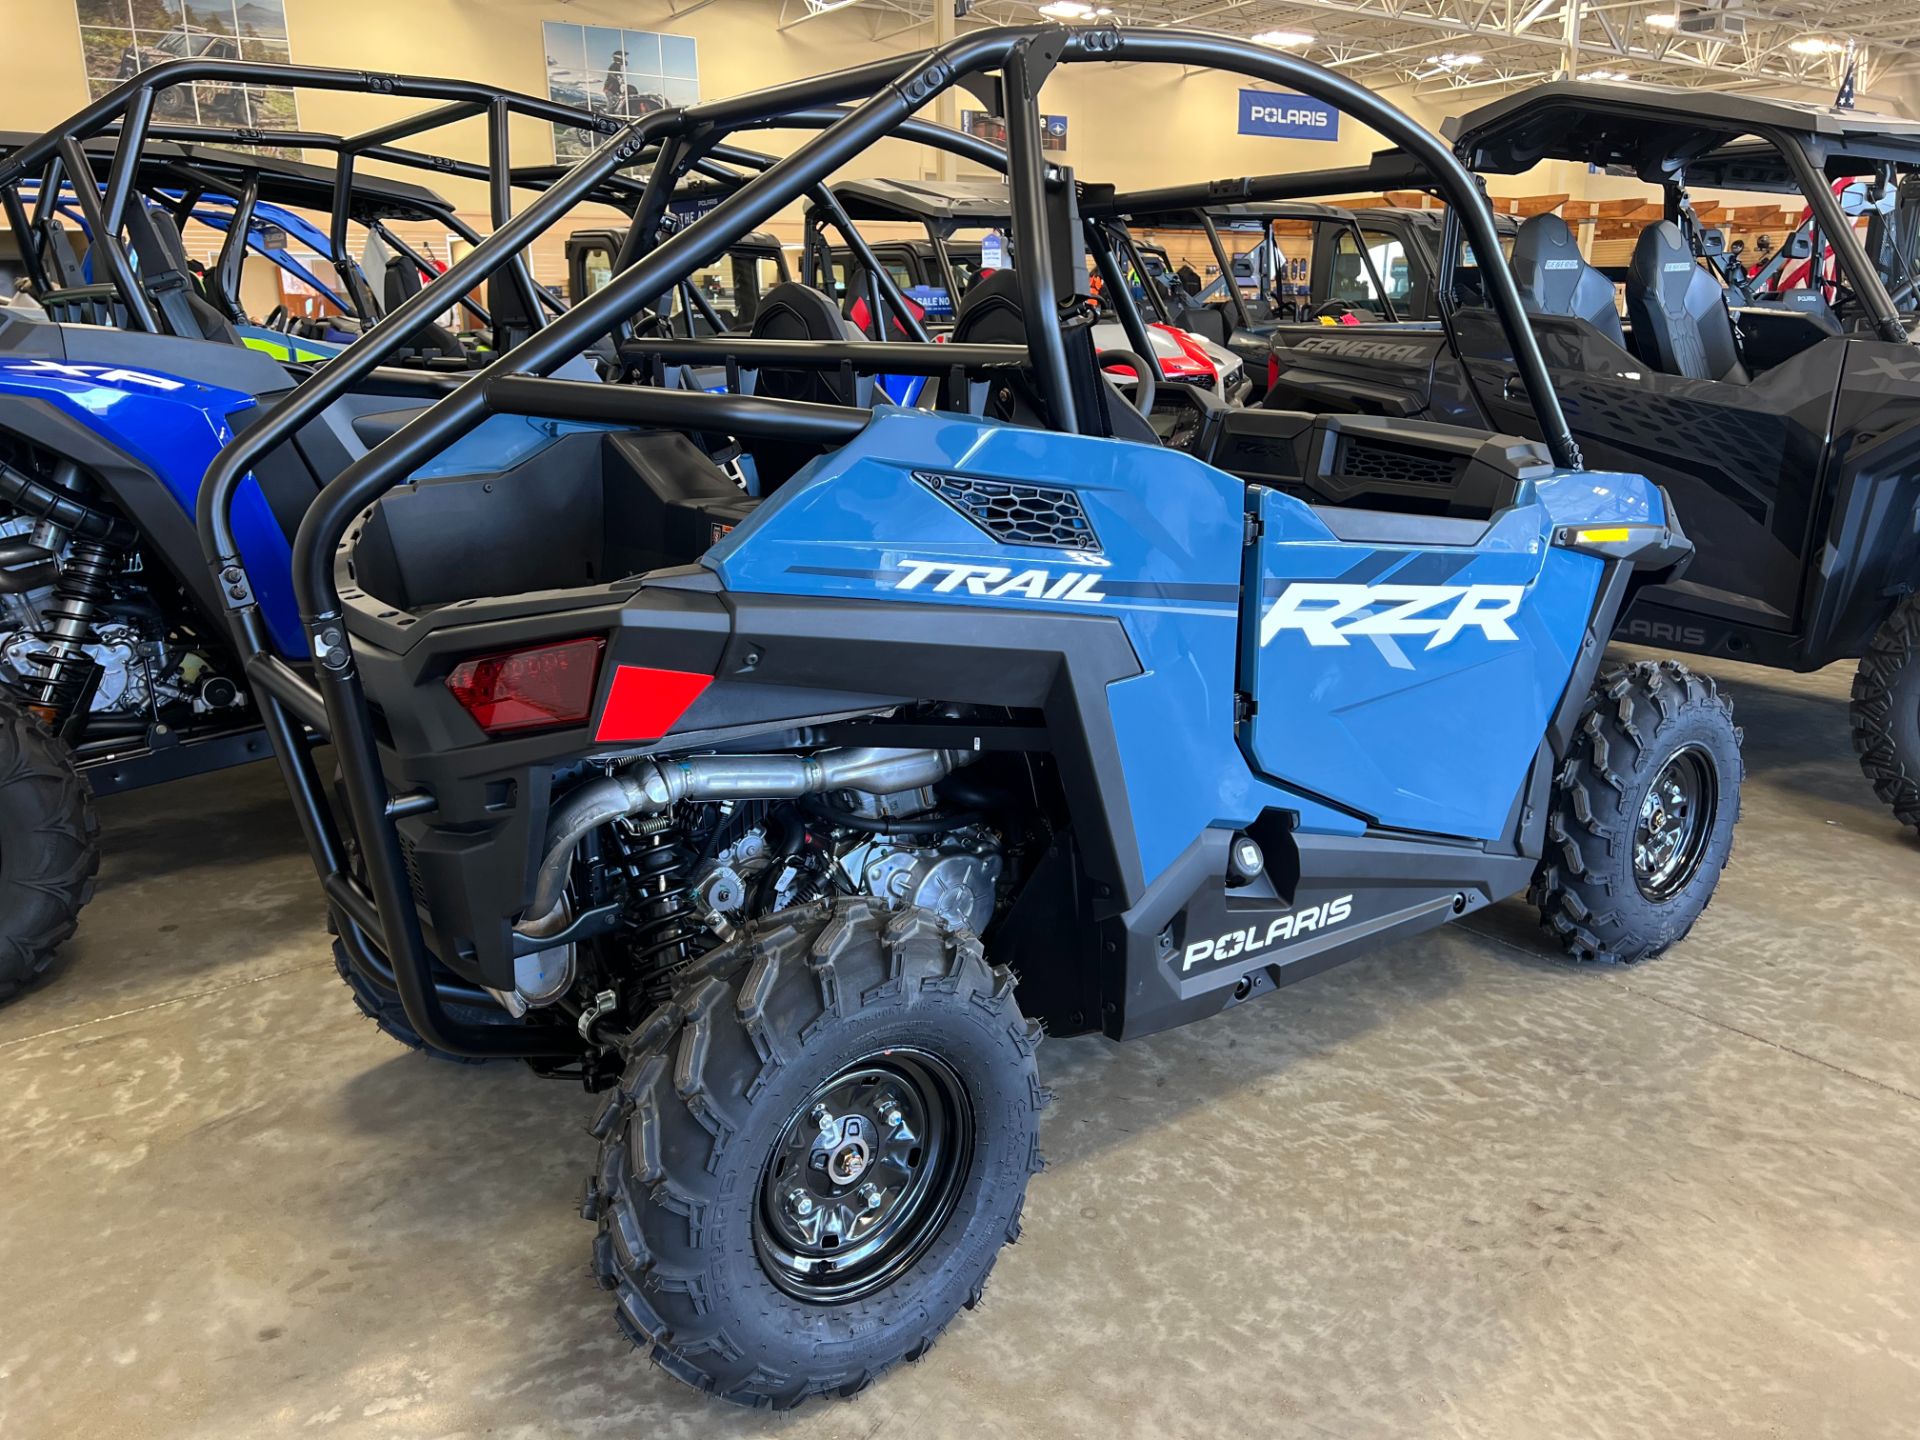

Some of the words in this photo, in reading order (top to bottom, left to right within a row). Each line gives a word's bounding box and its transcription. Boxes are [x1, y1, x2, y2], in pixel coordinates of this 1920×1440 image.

[1251, 106, 1328, 127] POLARIS
[679, 211, 695, 226] THE
[939, 296, 950, 306] NO
[1295, 337, 1427, 363] GENERAL
[3, 359, 185, 391] XP
[895, 560, 1106, 602] TRAIL
[1260, 583, 1526, 651] RZR
[1182, 894, 1354, 972] POLARIS
